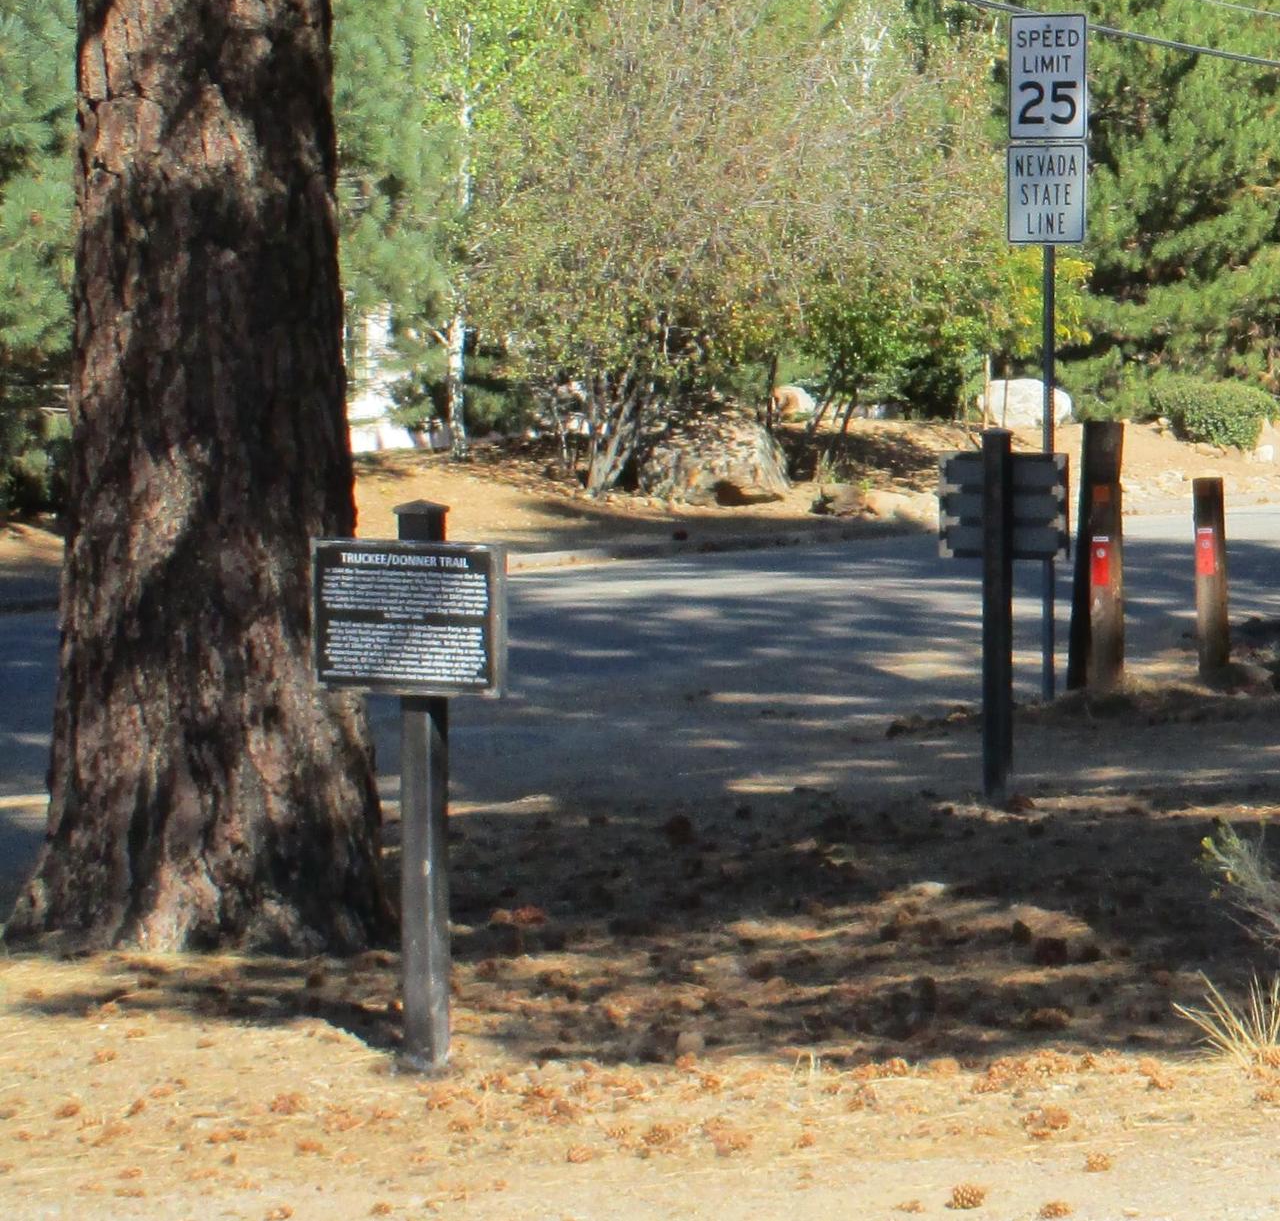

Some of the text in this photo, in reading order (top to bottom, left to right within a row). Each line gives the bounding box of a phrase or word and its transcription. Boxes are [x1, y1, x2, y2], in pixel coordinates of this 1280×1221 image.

[1016, 30, 1080, 48] SPEED
[1022, 55, 1072, 74] LIMIT
[1018, 81, 1078, 125] 25
[1015, 155, 1078, 177] NEVADA
[1020, 183, 1072, 206] STATE
[1027, 212, 1066, 235] LINE
[341, 552, 469, 568] TRUCKEE/DONNER TRAIL
